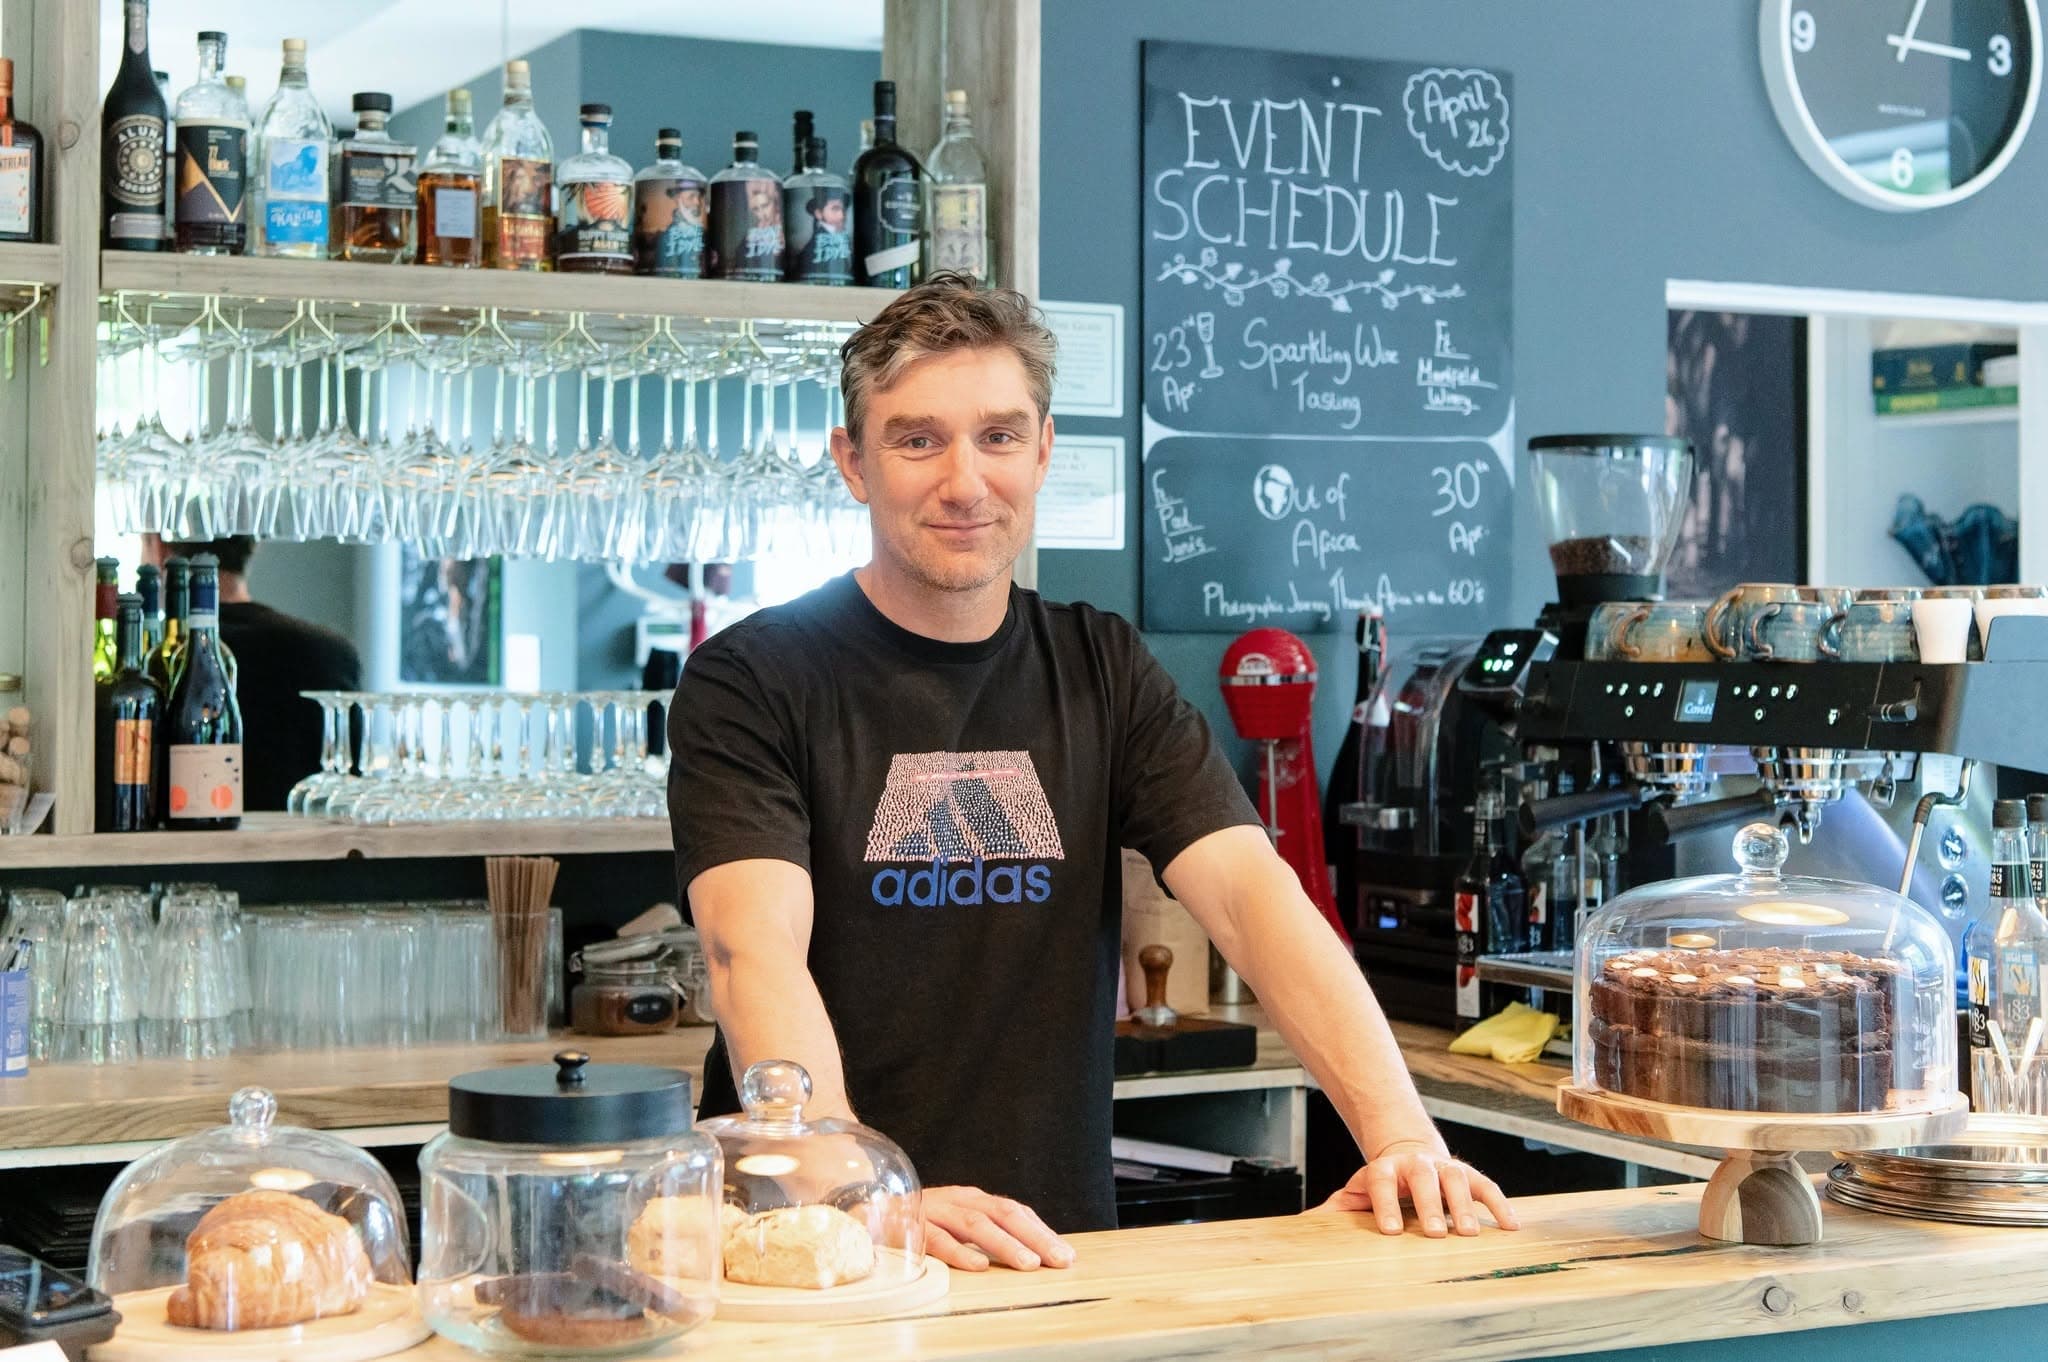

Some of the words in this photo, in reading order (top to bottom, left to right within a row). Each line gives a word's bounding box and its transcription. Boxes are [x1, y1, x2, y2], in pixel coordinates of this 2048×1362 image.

[1791, 10, 1816, 53] 9
[1987, 34, 2013, 76] 3
[1423, 78, 1491, 139] April
[1178, 91, 1382, 183] EVENT
[1889, 147, 1914, 189] 6
[1153, 168, 1459, 267] SCHEDULE
[1238, 316, 1352, 390] Sparkling
[1325, 471, 1351, 522] of
[871, 855, 1052, 907] adidas
